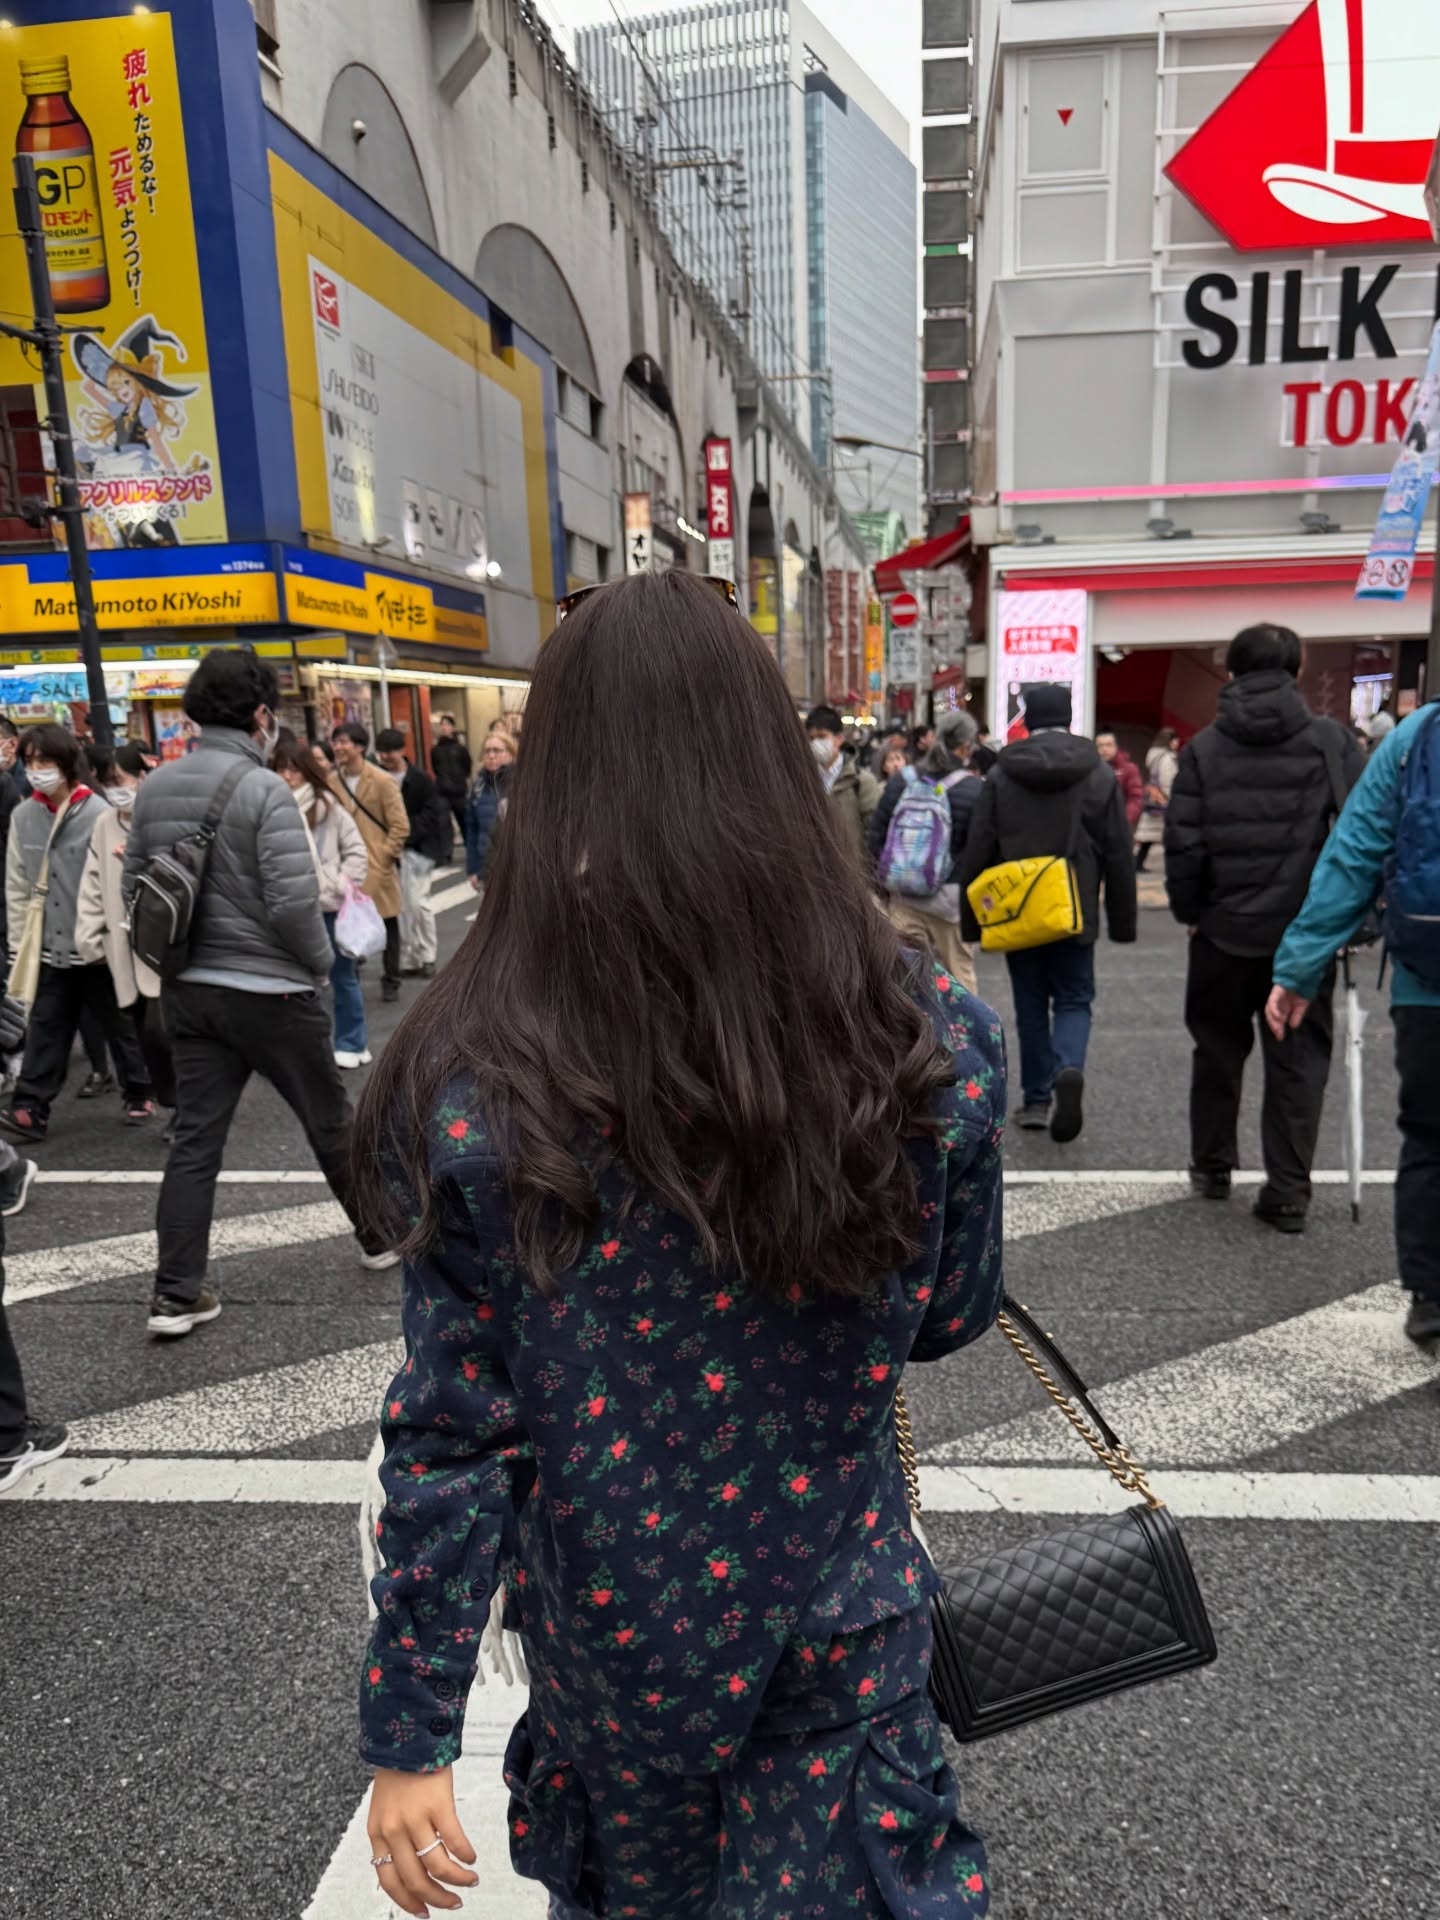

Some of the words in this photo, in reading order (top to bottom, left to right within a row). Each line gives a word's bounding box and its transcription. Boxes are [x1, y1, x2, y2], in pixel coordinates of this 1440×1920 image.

[122, 48, 157, 214] 疲れためるな!
[35, 165, 86, 206] GP
[43, 208, 94, 227] ロモント
[1181, 264, 1401, 368] SILK
[78, 474, 213, 507] アクリルスタンド
[710, 484, 729, 533] KFC
[34, 597, 158, 617] Matmoto
[162, 589, 242, 612] KiYoshi
